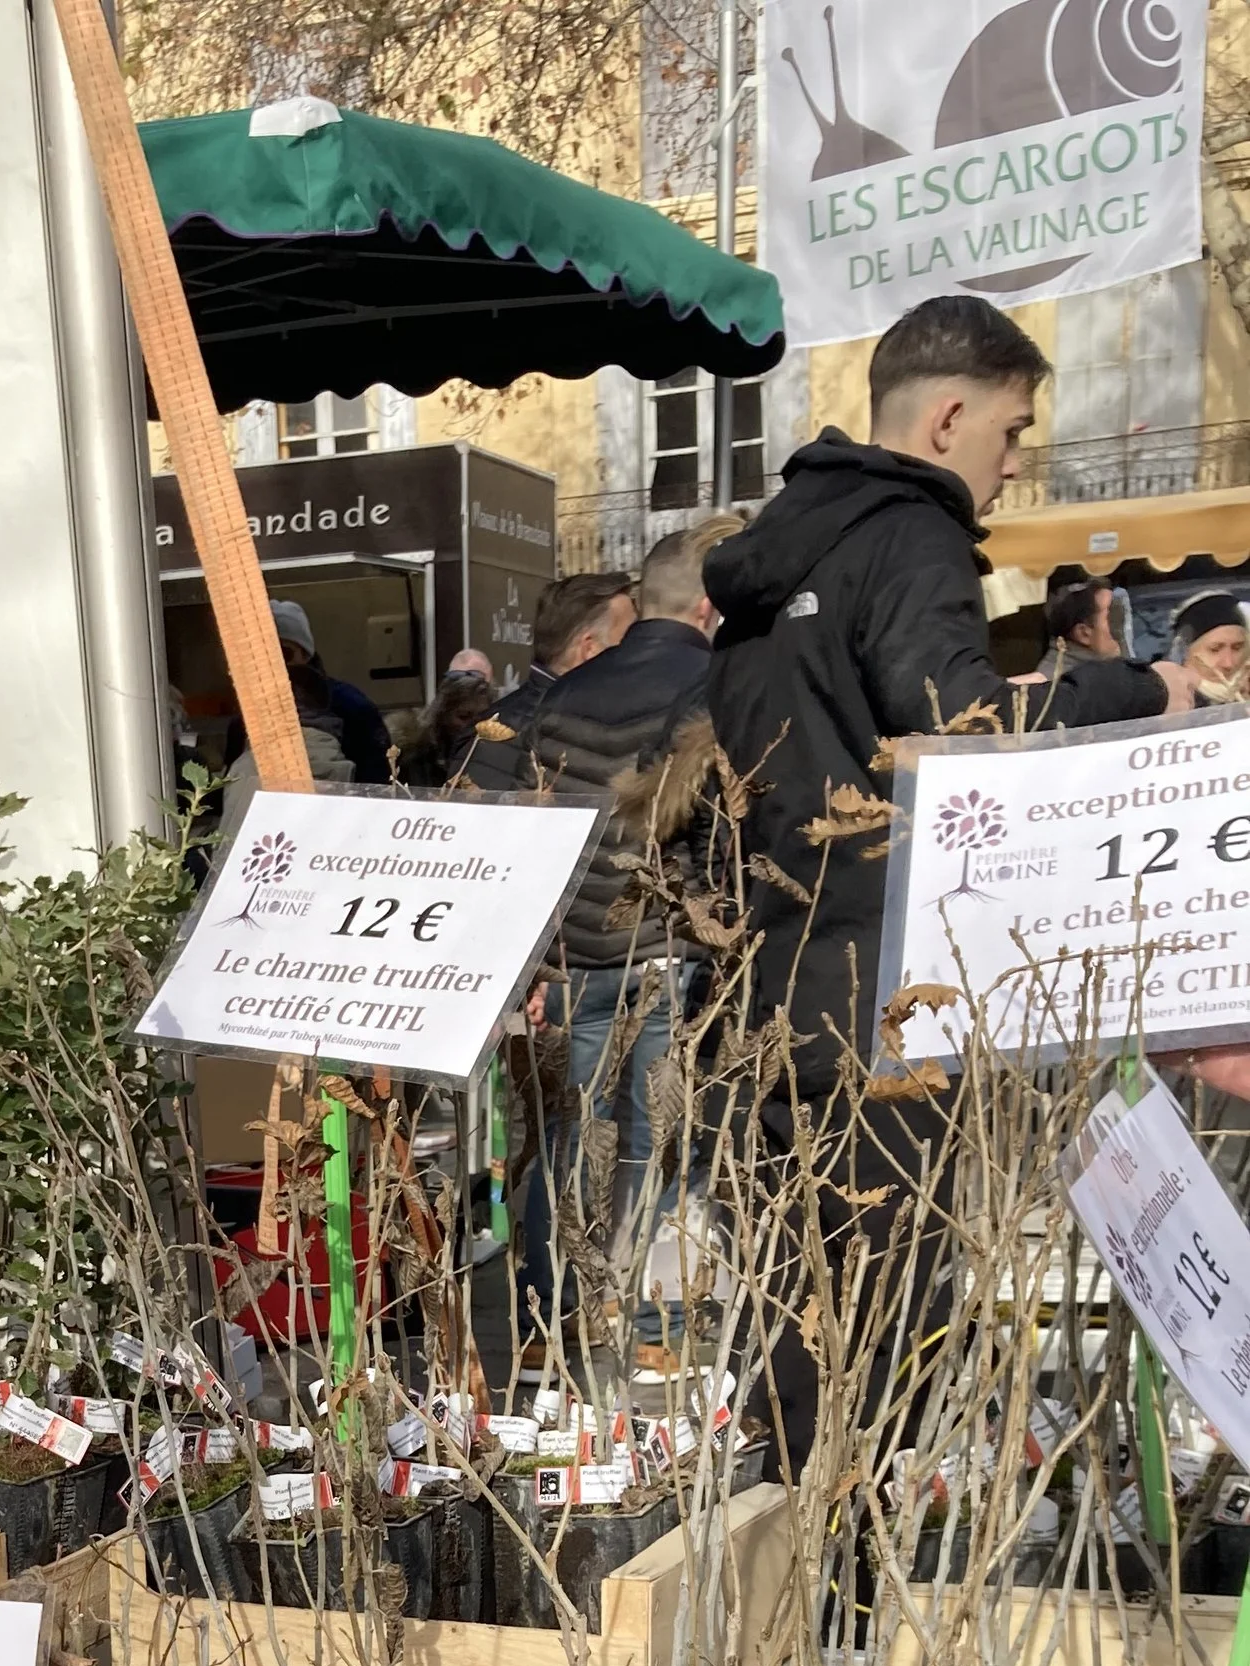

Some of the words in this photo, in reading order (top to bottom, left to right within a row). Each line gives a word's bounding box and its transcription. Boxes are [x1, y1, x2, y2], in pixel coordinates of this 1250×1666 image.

[808, 184, 877, 243] LES
[897, 103, 1188, 221] ESCARGOTS
[849, 248, 891, 290] DE
[907, 236, 955, 277] LA
[964, 192, 1149, 262] VAUNAGE
[248, 496, 391, 537] andade
[1128, 740, 1222, 771] Offre
[391, 817, 456, 842] Offre
[1094, 827, 1180, 882] 12
[1207, 815, 1250, 863] €
[331, 897, 401, 939] 12
[411, 902, 454, 943] €
[1012, 915, 1051, 937] Le
[214, 949, 249, 974] Le
[254, 953, 366, 984] charme
[373, 964, 492, 993] truffier
[1178, 963, 1250, 994] CTI
[225, 993, 334, 1025] certifié
[336, 1001, 426, 1034] CTIFL
[1179, 999, 1250, 1017] Mélanos
[217, 1021, 269, 1039] Mycorhizé
[270, 1029, 288, 1041] par
[321, 1032, 401, 1052] Mélanosporum
[1174, 1250, 1223, 1320] 12
